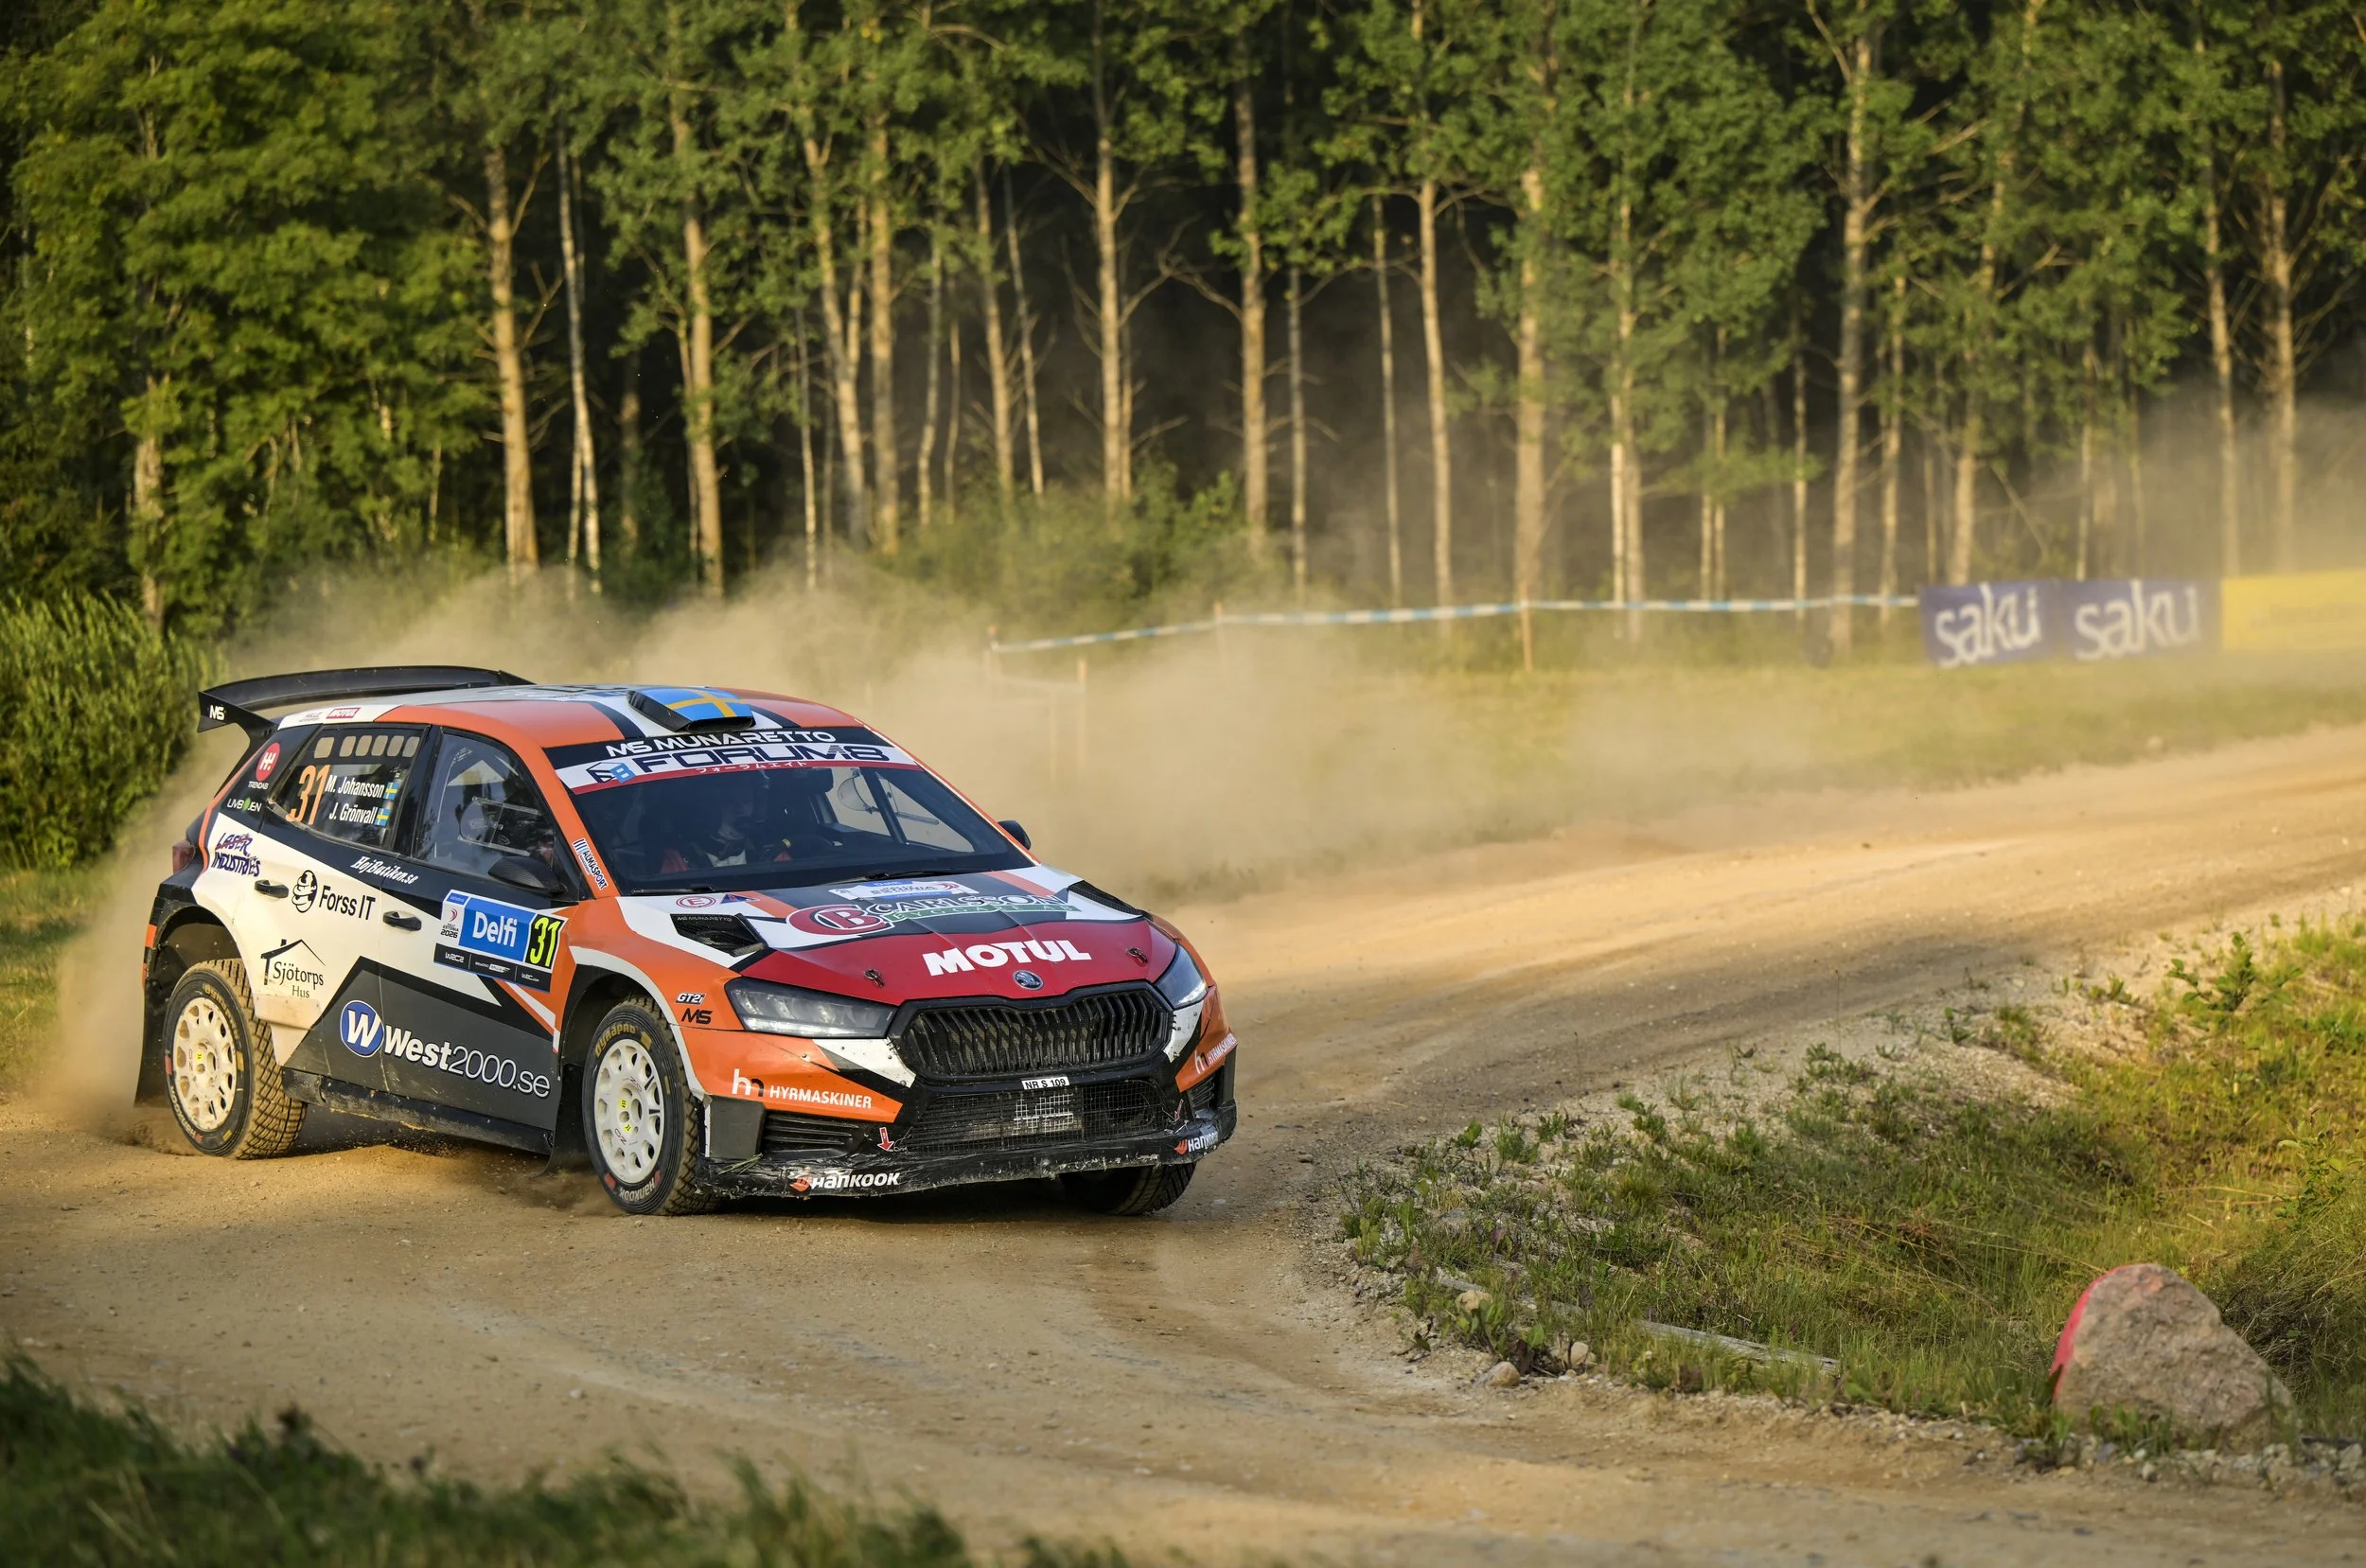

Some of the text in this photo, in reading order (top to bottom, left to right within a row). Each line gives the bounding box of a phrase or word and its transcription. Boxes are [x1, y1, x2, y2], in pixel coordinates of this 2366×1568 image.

[1934, 583, 2041, 669] saku
[2075, 579, 2200, 661] saku
[209, 704, 225, 721] MS
[606, 731, 837, 757] MS MUNARETTO
[632, 745, 887, 772] FORUM8
[697, 761, 806, 773] フォーラムエイト
[286, 765, 330, 825] 31
[325, 775, 385, 799] M. Johansson
[329, 802, 377, 824] J. Grönvall
[582, 850, 608, 890] ALMASPORT
[319, 885, 376, 921] Forss IT
[867, 894, 1068, 916] CARLSSON
[440, 928, 459, 939] 2026
[472, 911, 518, 947] Delfi
[530, 917, 561, 967] 31
[922, 940, 1092, 977] MOTUL
[273, 961, 324, 990] Sjötorps
[292, 985, 309, 998] Hus
[347, 1010, 381, 1048] W
[681, 1008, 713, 1025] MS
[384, 1024, 551, 1098] West2000.se
[769, 1085, 873, 1108] HYRMASKINER
[1025, 1077, 1067, 1089] NR S 109
